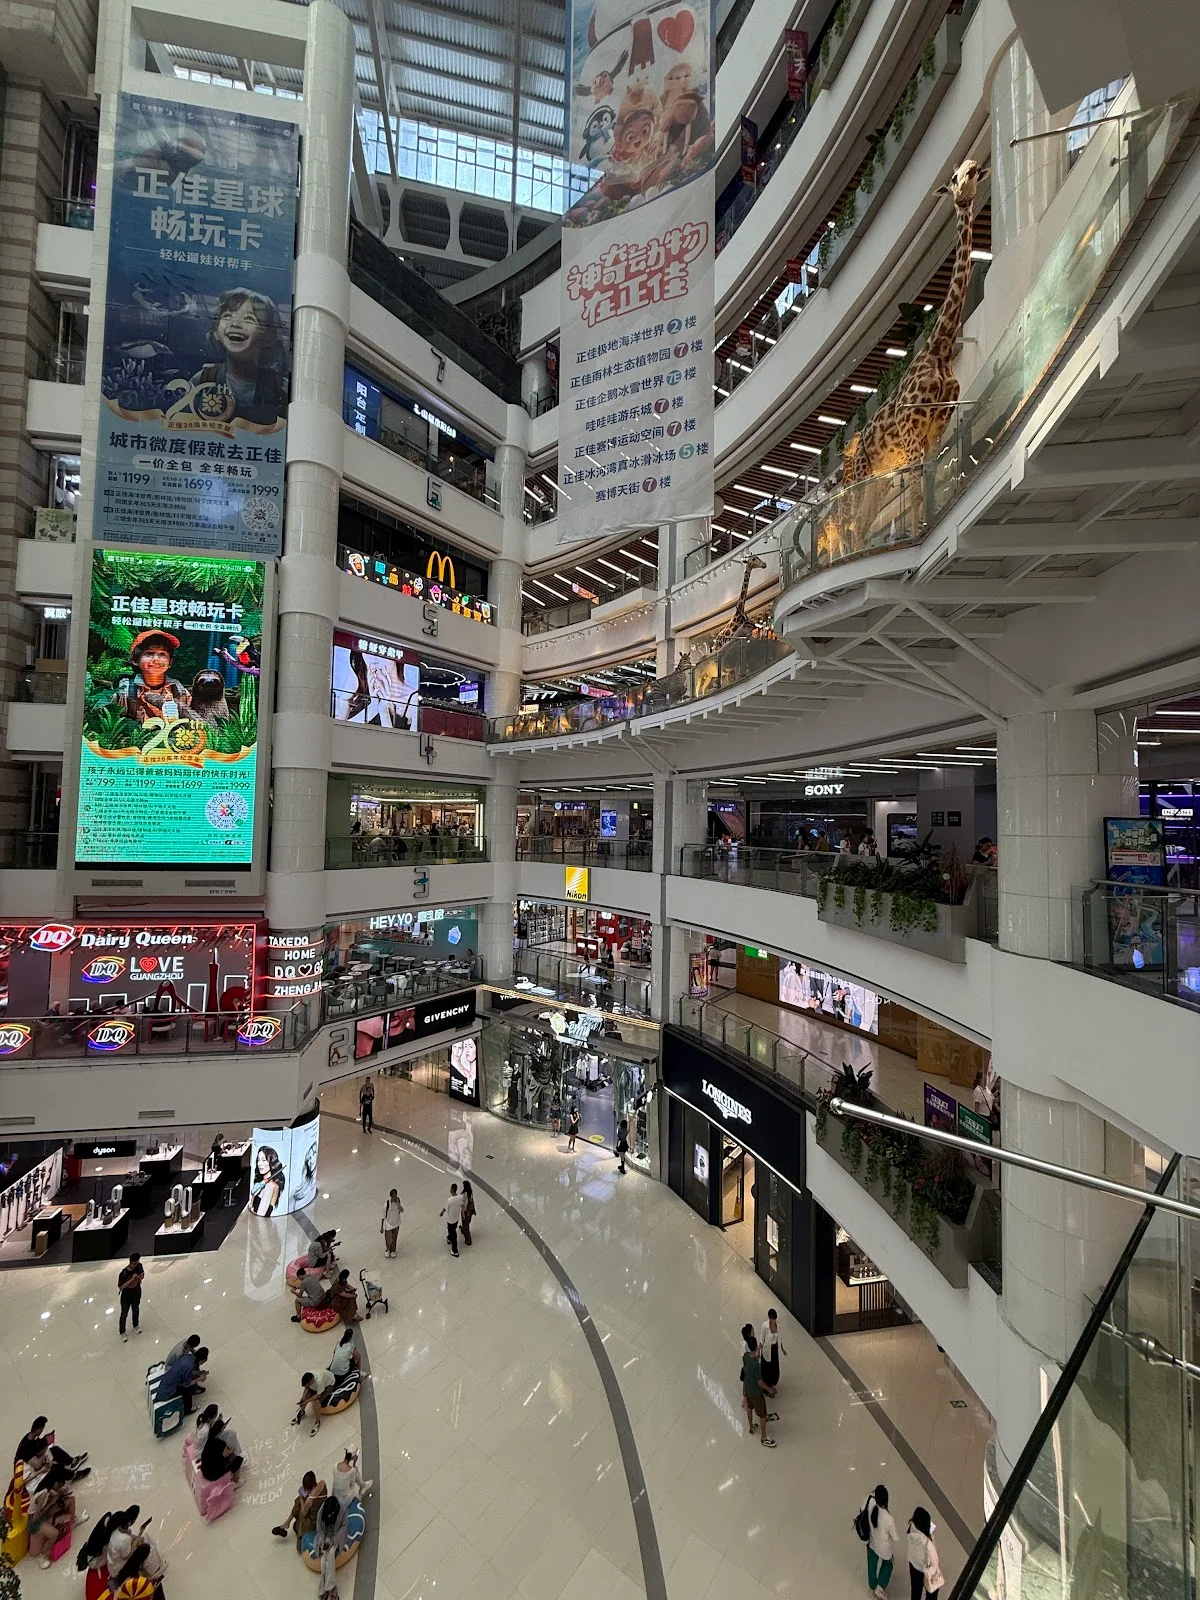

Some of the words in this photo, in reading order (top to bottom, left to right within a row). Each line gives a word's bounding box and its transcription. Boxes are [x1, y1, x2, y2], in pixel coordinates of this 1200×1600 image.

[132, 167, 285, 219] 正佳星球
[150, 206, 264, 251] 畅玩卡
[160, 249, 253, 270] 轻松遛娃好帮手
[581, 261, 689, 328] 在正佳
[109, 431, 282, 464] 城市微度假就去正佳
[139, 458, 193, 471] 一价全包
[199, 464, 252, 478] 全年畅玩
[111, 595, 245, 620] 正佳星球畅玩卡
[111, 615, 183, 631] 轻松遛娃好帮手
[804, 783, 844, 796] SONY
[566, 889, 588, 900] Nikon
[38, 930, 68, 945] DQ
[81, 933, 131, 948] Dairy
[135, 931, 194, 946] Queen
[284, 947, 316, 961] HOME
[90, 961, 118, 977] DQ
[130, 971, 184, 981] GUANGZHOU
[274, 965, 296, 979] DQ
[423, 1004, 470, 1025] GIVENCHY
[96, 1027, 128, 1043] DQ
[247, 1022, 277, 1038] DQ
[701, 1078, 752, 1124] LONGINES
[93, 1145, 116, 1156] dyson
